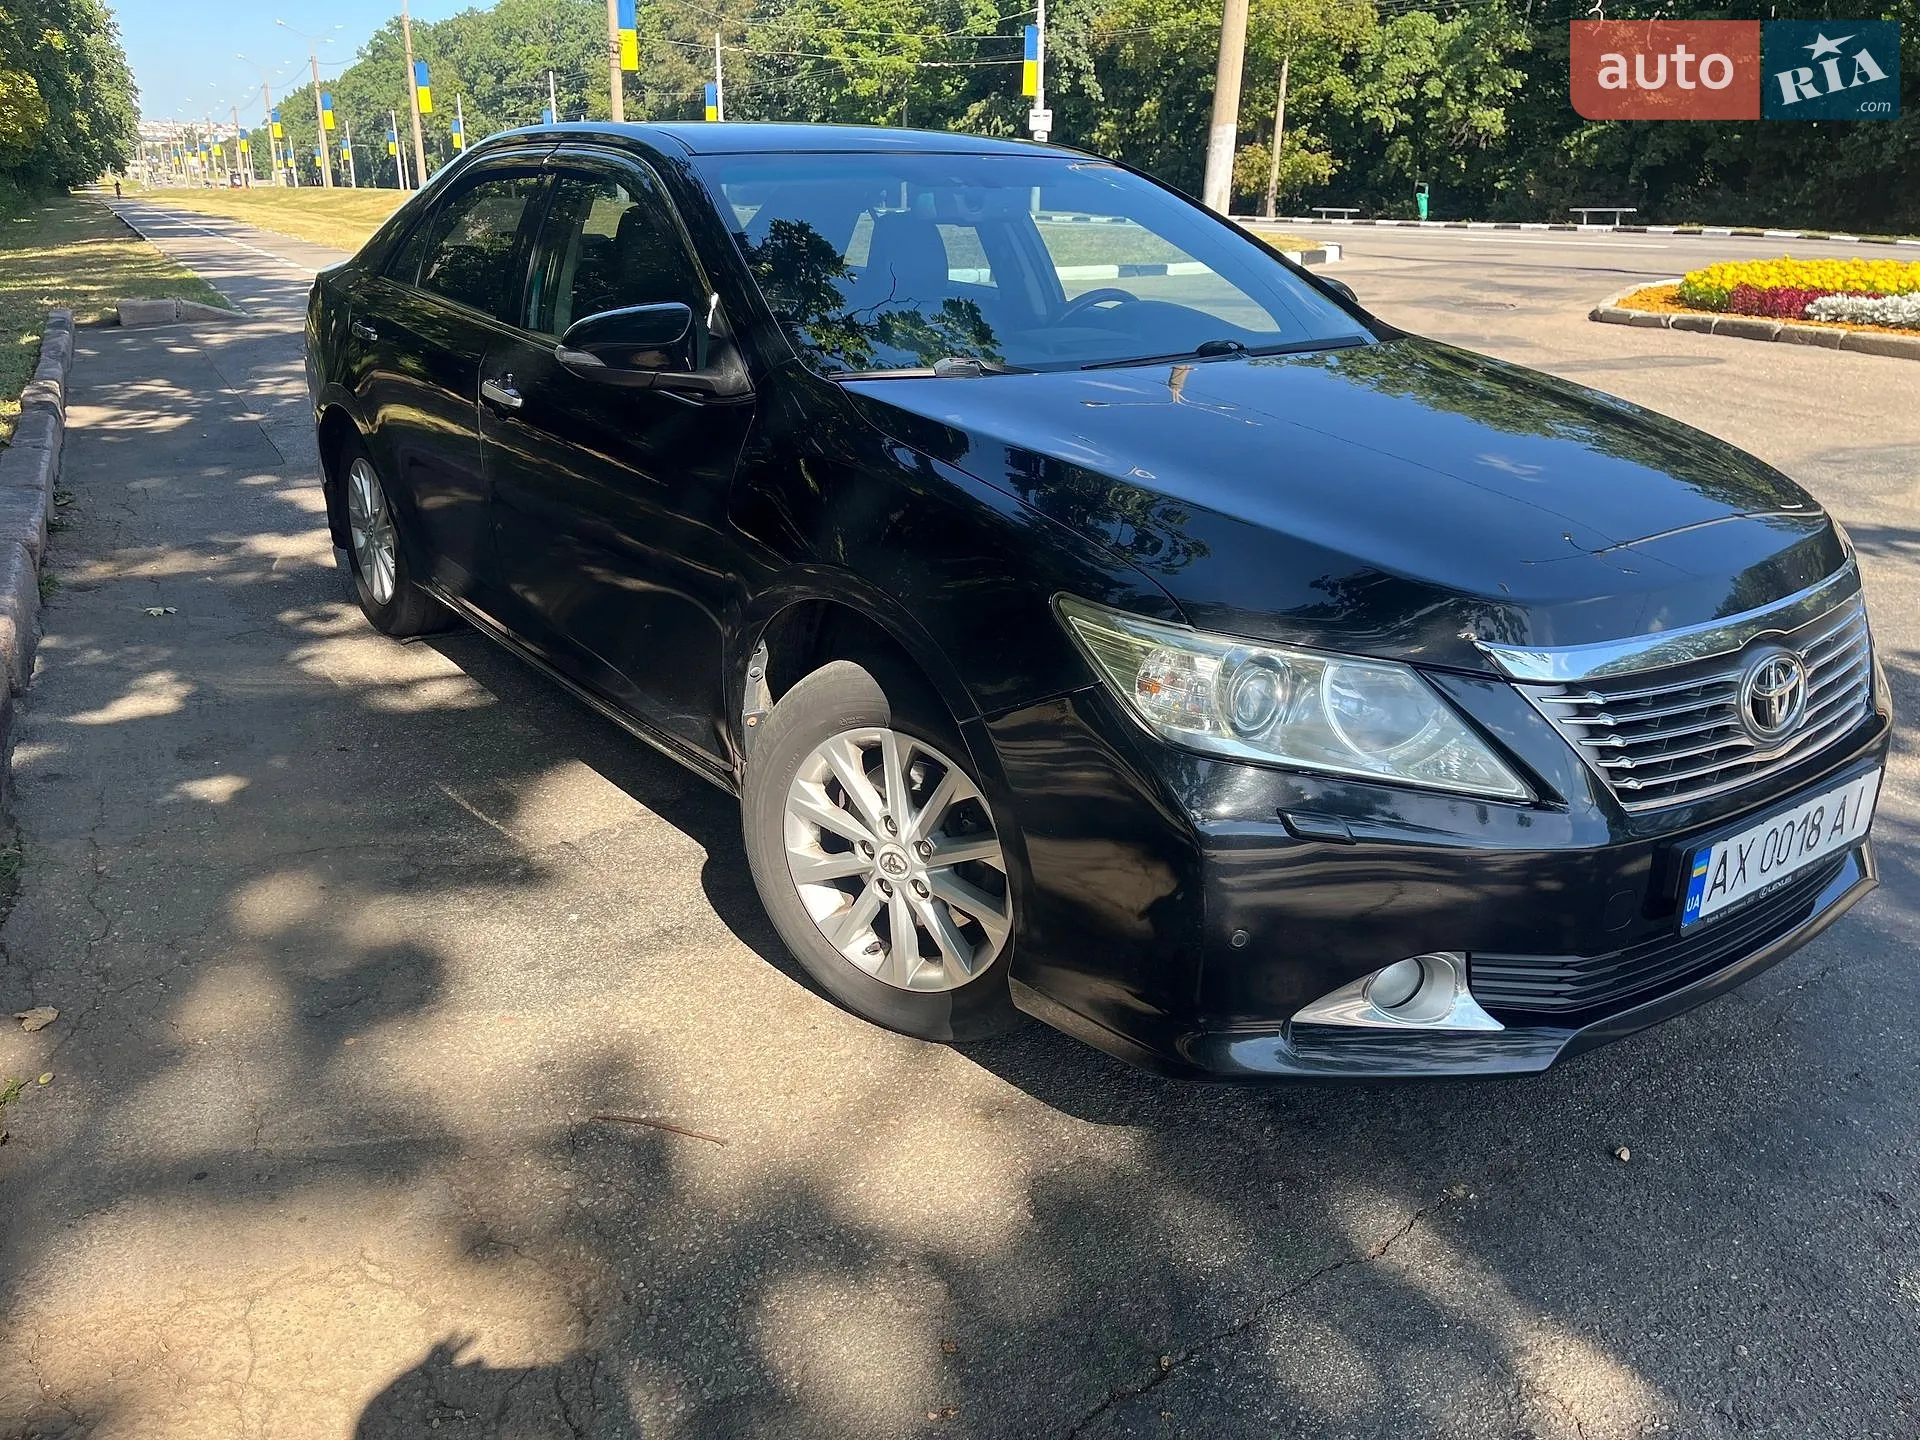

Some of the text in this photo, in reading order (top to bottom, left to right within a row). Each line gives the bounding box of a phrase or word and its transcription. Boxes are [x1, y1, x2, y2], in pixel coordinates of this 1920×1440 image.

[1706, 836, 1756, 902] AX
[1759, 805, 1825, 876] 0018
[1827, 785, 1865, 842] AI
[1686, 893, 1700, 912] UA
